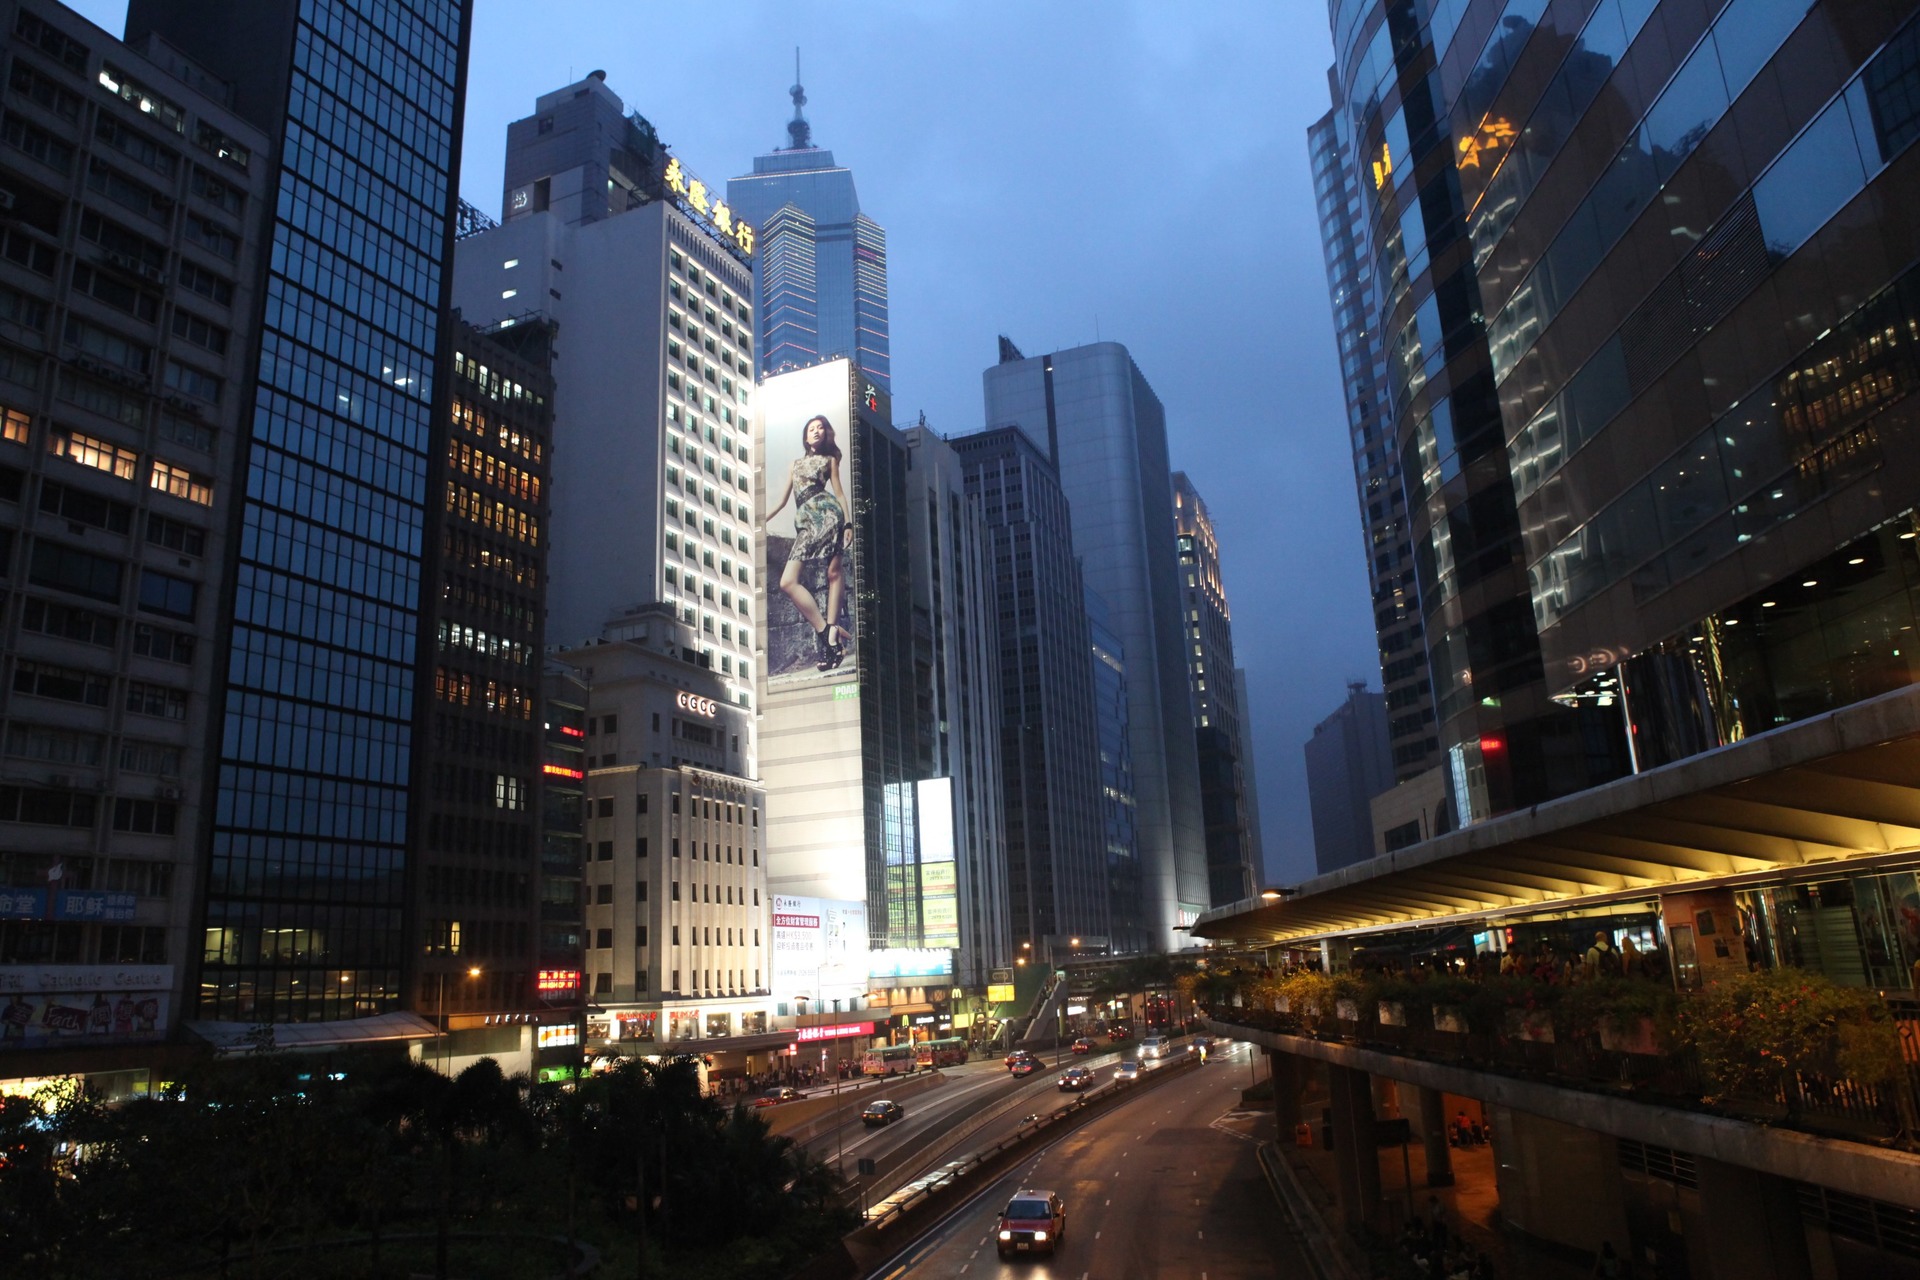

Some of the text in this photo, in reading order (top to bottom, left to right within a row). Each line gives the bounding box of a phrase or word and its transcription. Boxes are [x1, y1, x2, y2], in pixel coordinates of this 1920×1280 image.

[664, 158, 754, 255] 永隆銀行
[835, 684, 857, 696] POAD
[65, 895, 105, 916] 耶穌
[38, 972, 103, 987] Catholic
[114, 971, 162, 985] Centre
